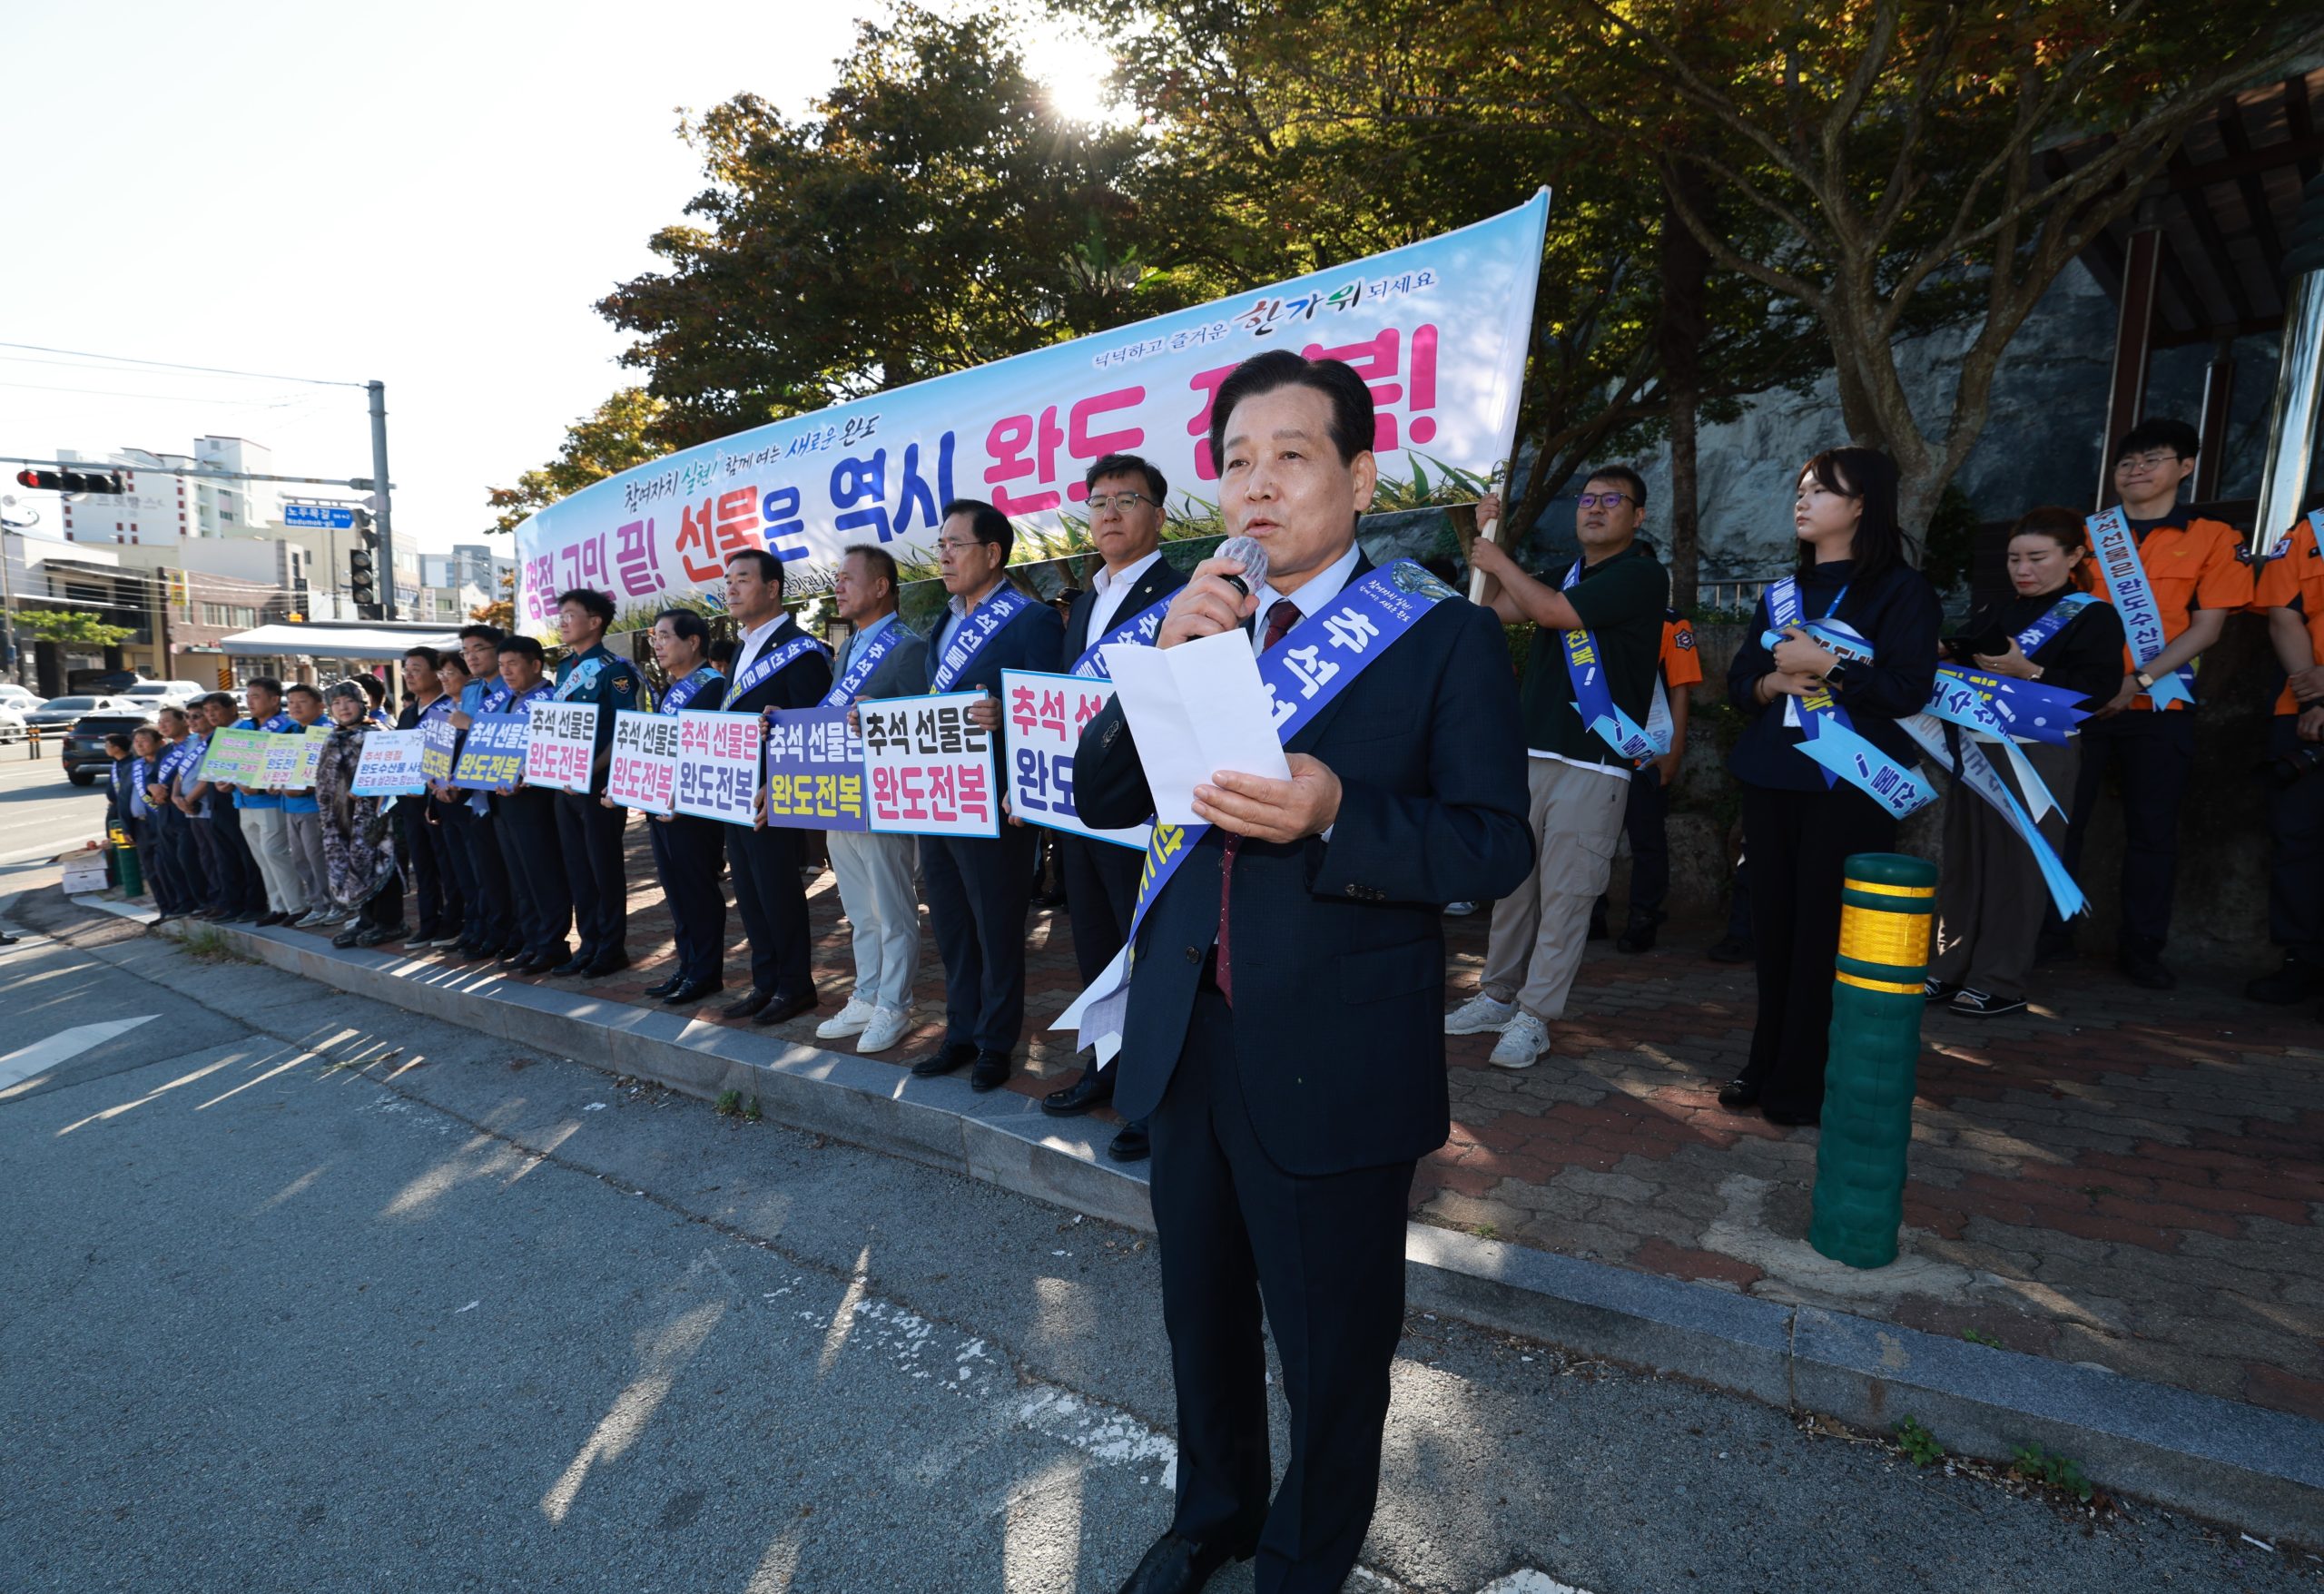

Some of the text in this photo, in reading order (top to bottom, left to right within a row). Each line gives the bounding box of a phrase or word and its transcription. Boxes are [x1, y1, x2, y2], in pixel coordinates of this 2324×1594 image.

[1169, 323, 1227, 350] 즐거운
[1234, 281, 1361, 336] 한가위
[1367, 271, 1435, 300] 되세요
[624, 469, 680, 515] 참여자치
[681, 461, 720, 497] 실현!
[784, 427, 836, 459] 새로운
[839, 415, 881, 448] 완도
[526, 551, 563, 620] 명절
[562, 532, 616, 603] 고민
[616, 517, 666, 597] 끝!
[675, 486, 809, 583] 선물은
[830, 430, 956, 543] 역시
[983, 385, 1146, 517] 완도
[469, 722, 529, 750] 추석 선물은
[532, 708, 595, 741] 추석 선물은
[866, 706, 988, 755] 추석 선물은
[1011, 685, 1066, 742] 추석
[616, 719, 677, 758] 추석 선물은
[681, 719, 759, 761] 추석 선물은
[769, 722, 863, 763] 추석 선물은
[456, 753, 522, 783] 완도전복
[529, 743, 589, 783] 완도전복
[612, 757, 674, 806] 완도전복
[680, 762, 753, 814] 완도전복
[772, 772, 862, 819] 완도전복
[872, 763, 988, 822] 완도전복
